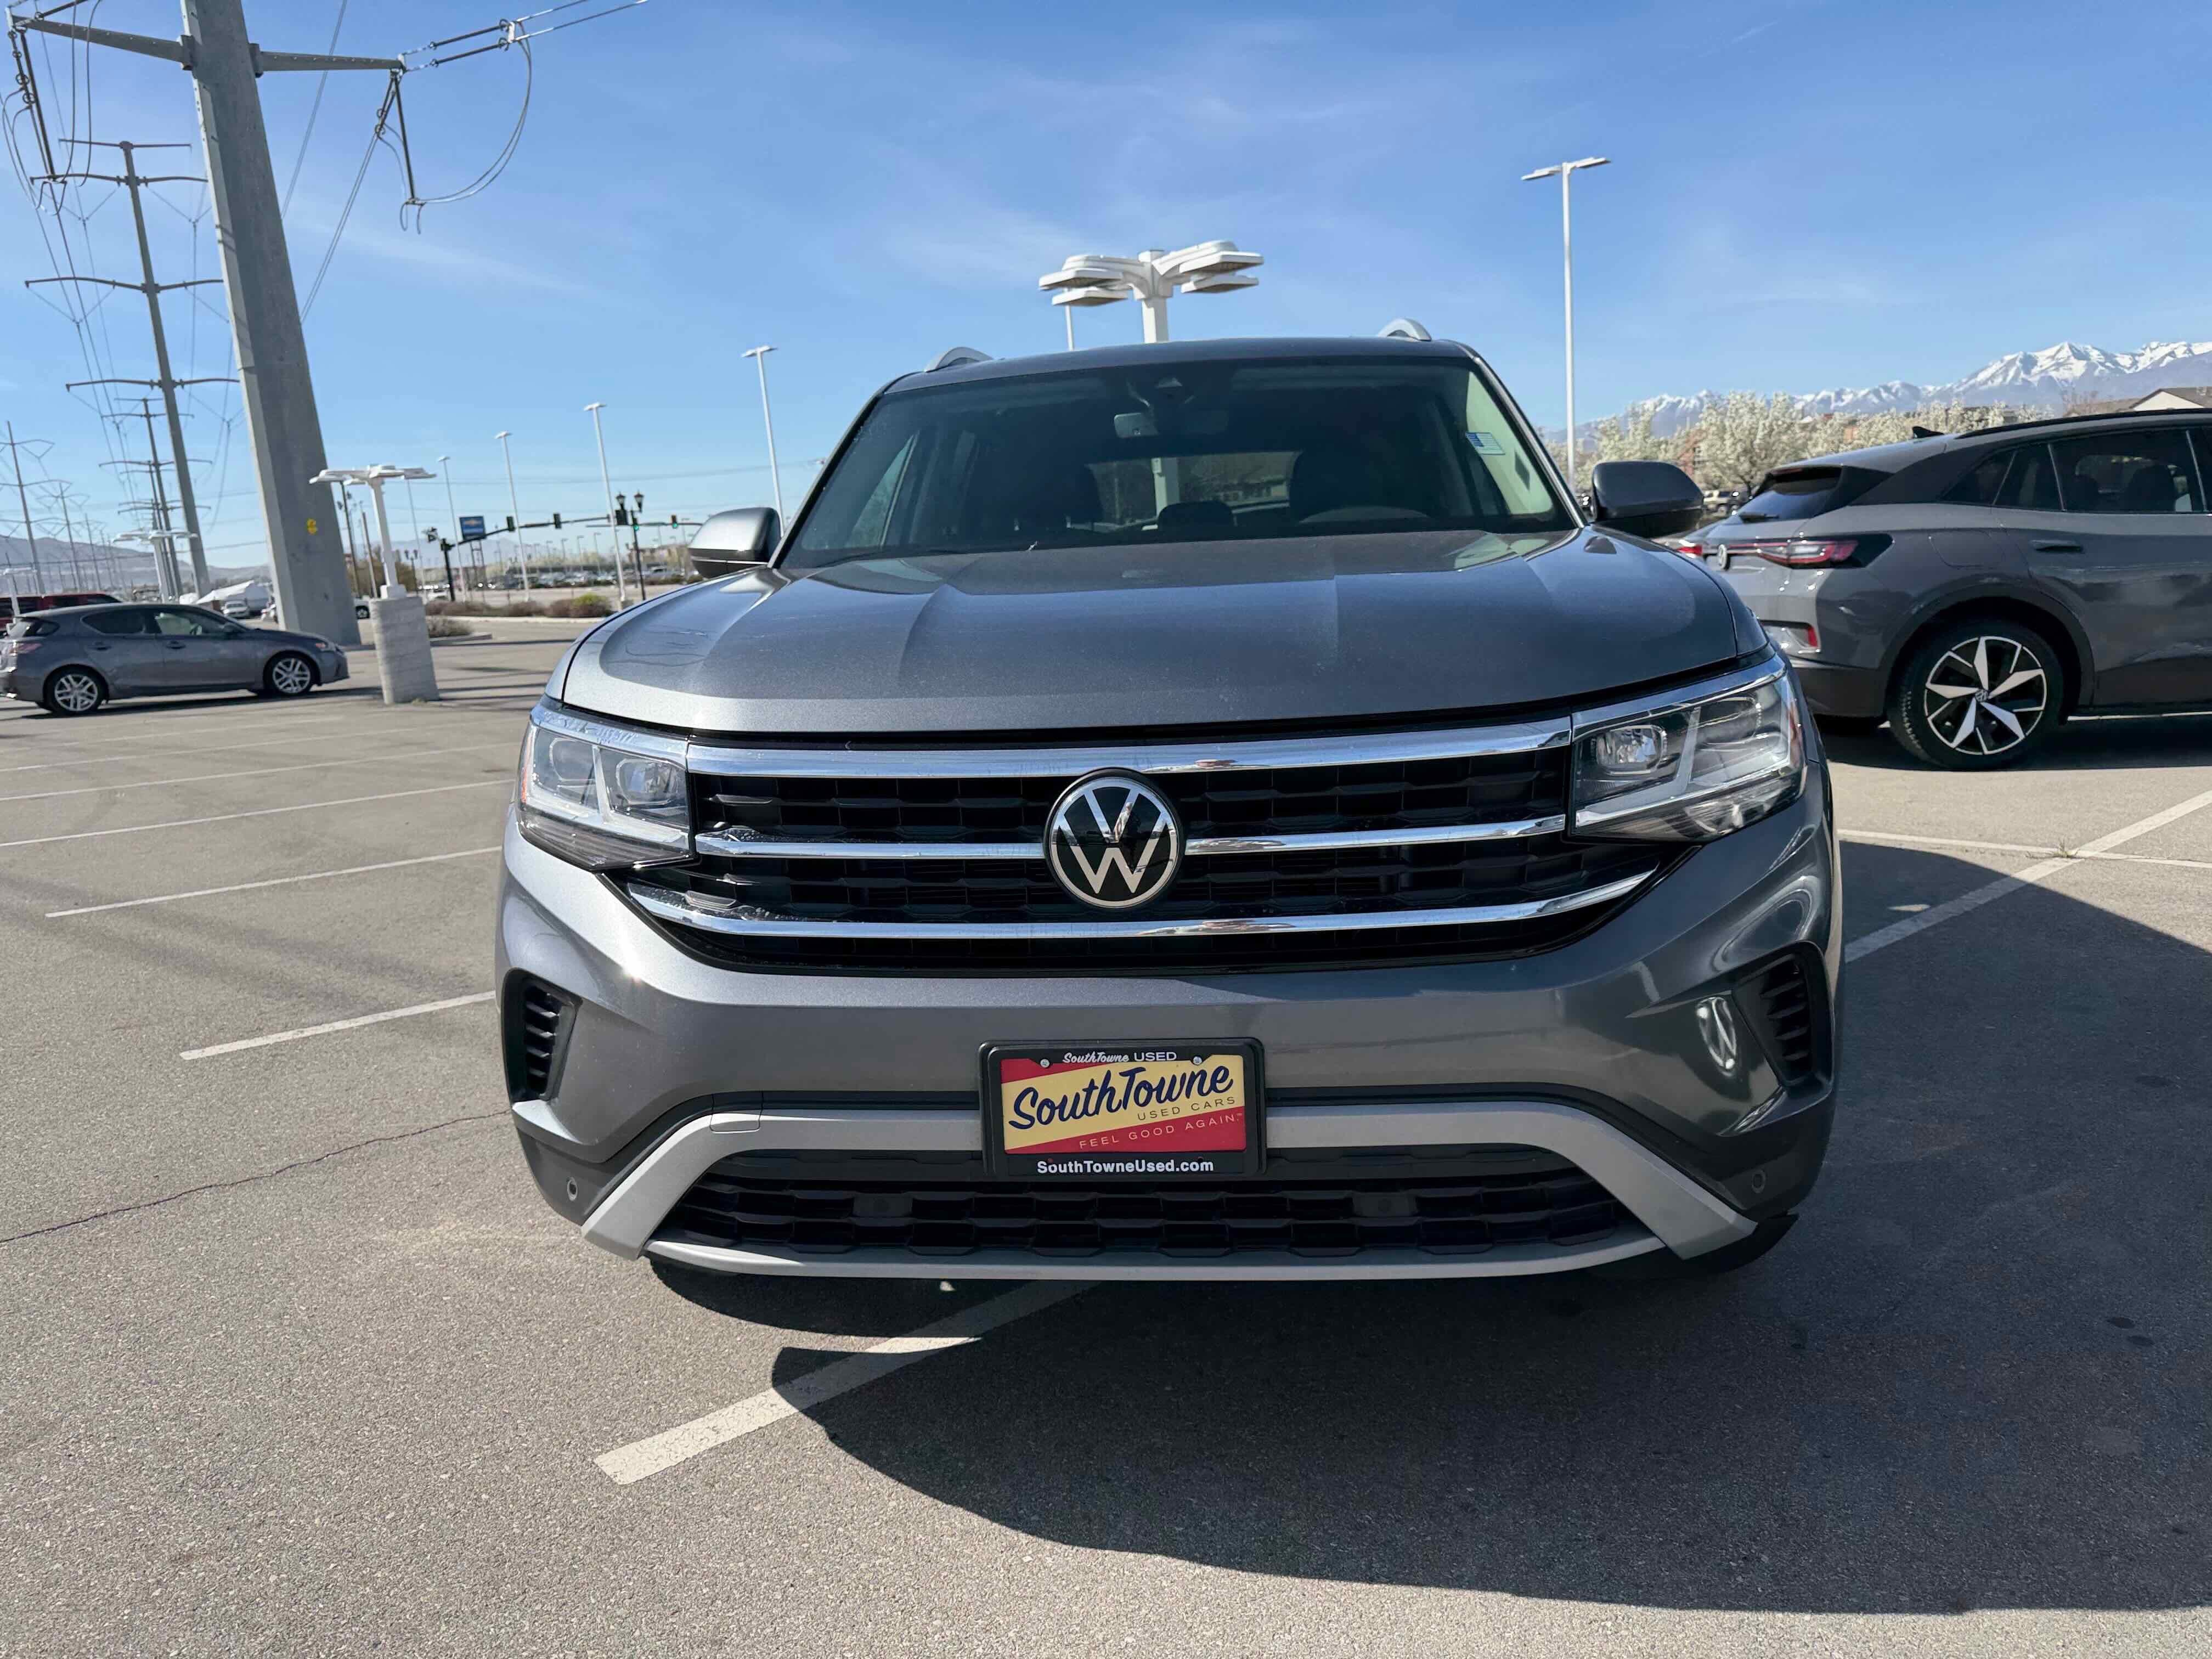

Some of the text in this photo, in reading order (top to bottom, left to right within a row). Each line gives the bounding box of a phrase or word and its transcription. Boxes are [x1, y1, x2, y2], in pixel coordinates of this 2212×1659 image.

[1054, 781, 1172, 898] VW
[1062, 1051, 1177, 1063] SouthTowne USED
[1008, 1065, 1234, 1130] SouthTowne
[1137, 1097, 1235, 1120] USED CARS
[1079, 1135, 1119, 1149] FEEL
[1128, 1125, 1175, 1140] GOOD
[1037, 1159, 1214, 1173] SouthTowneUsed.com
